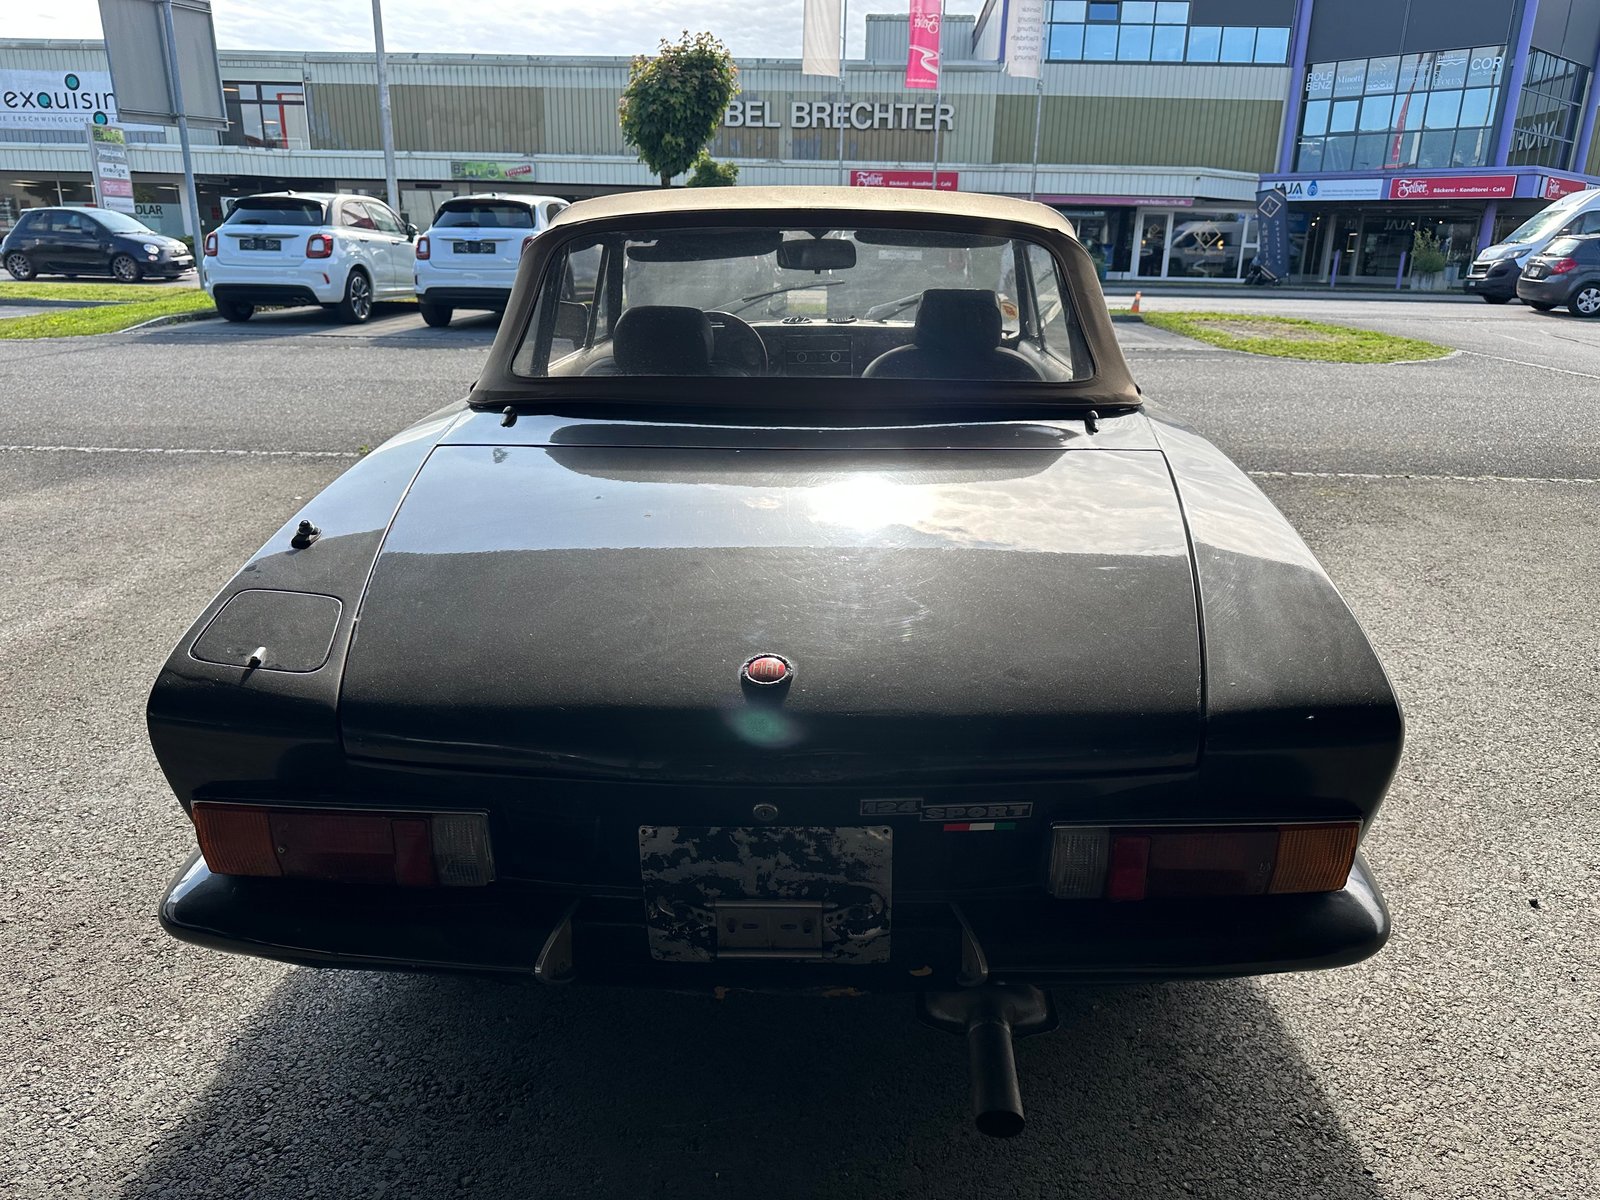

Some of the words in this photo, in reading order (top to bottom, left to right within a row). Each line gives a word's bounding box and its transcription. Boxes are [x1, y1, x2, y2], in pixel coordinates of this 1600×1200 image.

[1471, 56, 1502, 70] COR
[1307, 71, 1333, 82] ROLF
[1305, 81, 1332, 92] BENZ
[791, 101, 955, 131] BRECHTER
[1398, 180, 1429, 197] Felber
[753, 661, 780, 675] FIAT
[863, 800, 918, 814] 124
[926, 804, 1029, 819] SPORT
